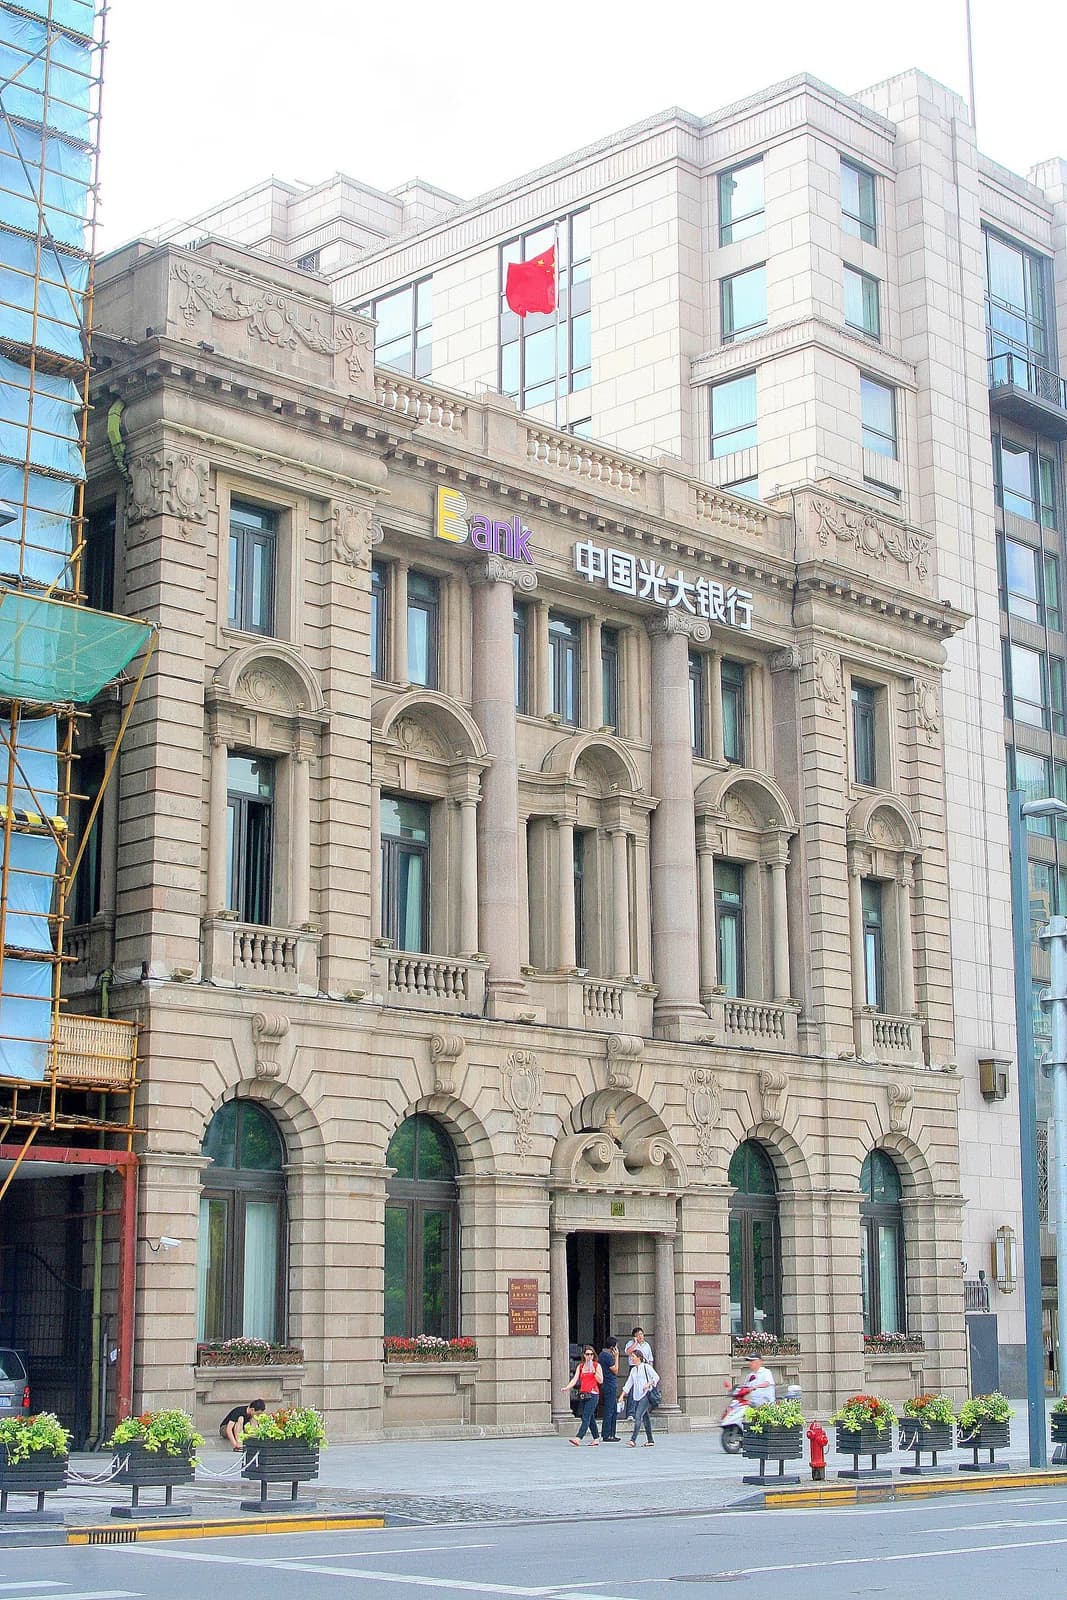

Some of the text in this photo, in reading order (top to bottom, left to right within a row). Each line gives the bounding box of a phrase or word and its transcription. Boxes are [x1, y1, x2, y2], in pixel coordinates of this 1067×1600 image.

[437, 484, 535, 564] Bank
[575, 540, 753, 631] 中国光大银行
